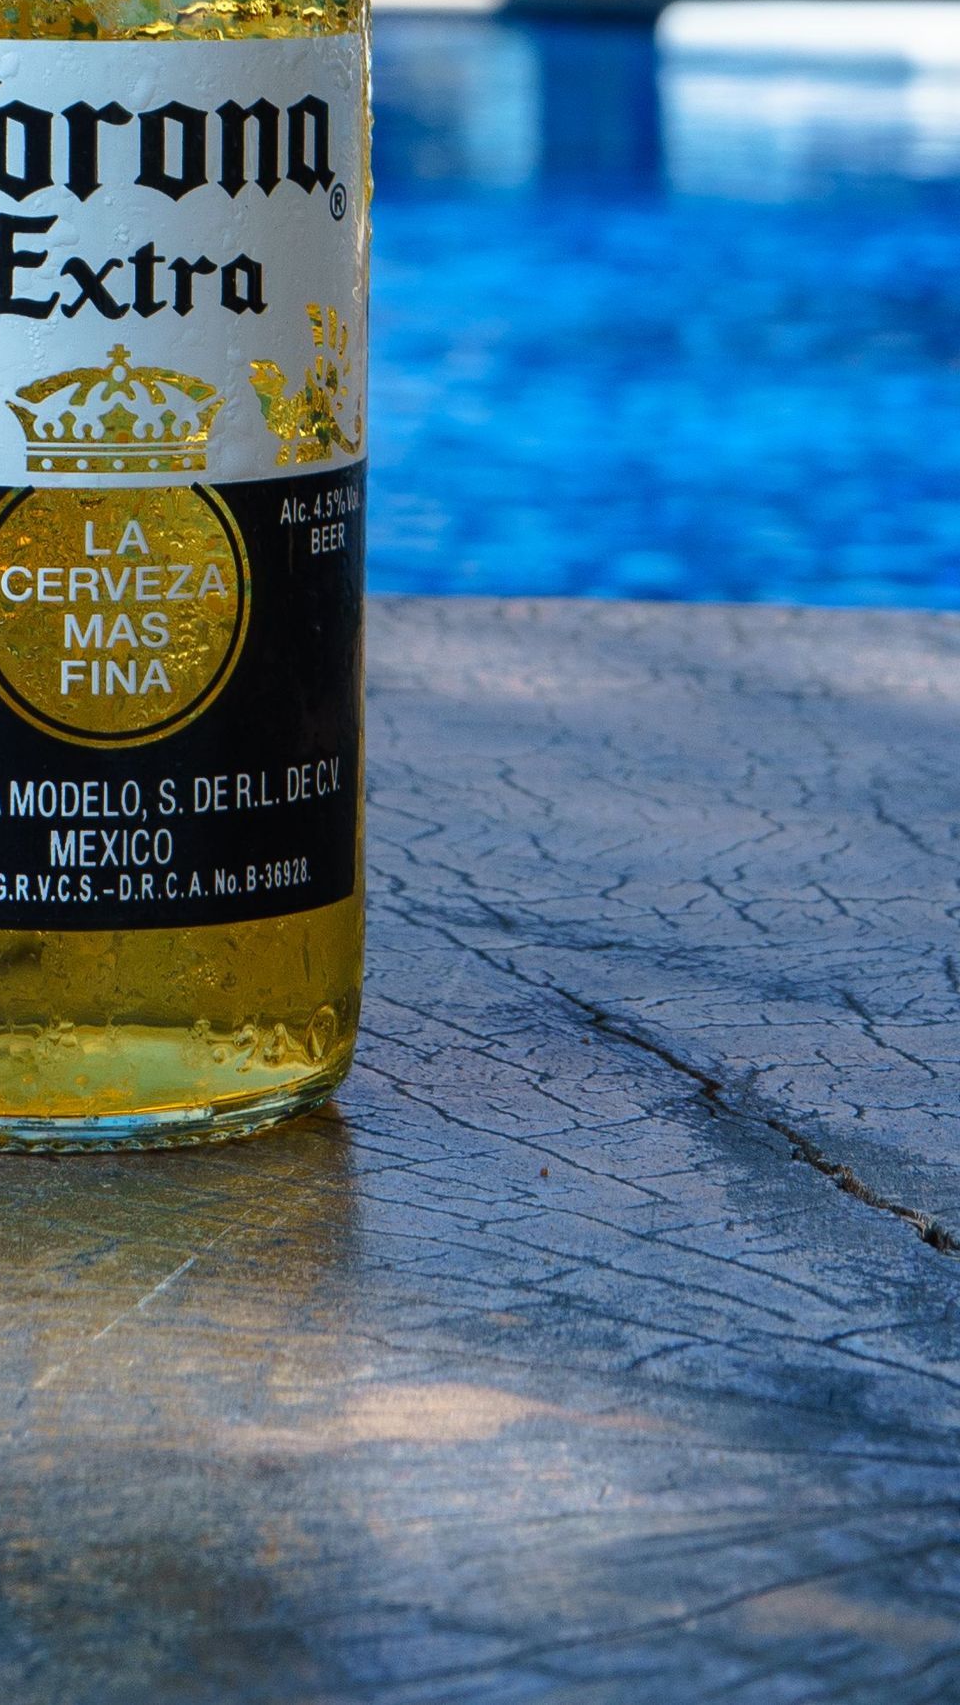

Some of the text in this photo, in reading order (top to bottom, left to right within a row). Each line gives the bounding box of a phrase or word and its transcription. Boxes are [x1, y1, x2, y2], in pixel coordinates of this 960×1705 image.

[280, 496, 312, 526] Alc.
[313, 487, 346, 519] 4.5%
[84, 520, 150, 557] LA
[311, 522, 346, 555] BEER
[0, 563, 228, 602] CERVEZA
[63, 611, 171, 649] MAS
[60, 659, 173, 696] FINA
[8, 779, 148, 823] MODELO,
[158, 778, 184, 816] S.
[194, 775, 229, 814] DE
[287, 763, 312, 802] DE
[49, 827, 174, 868] MEXICO
